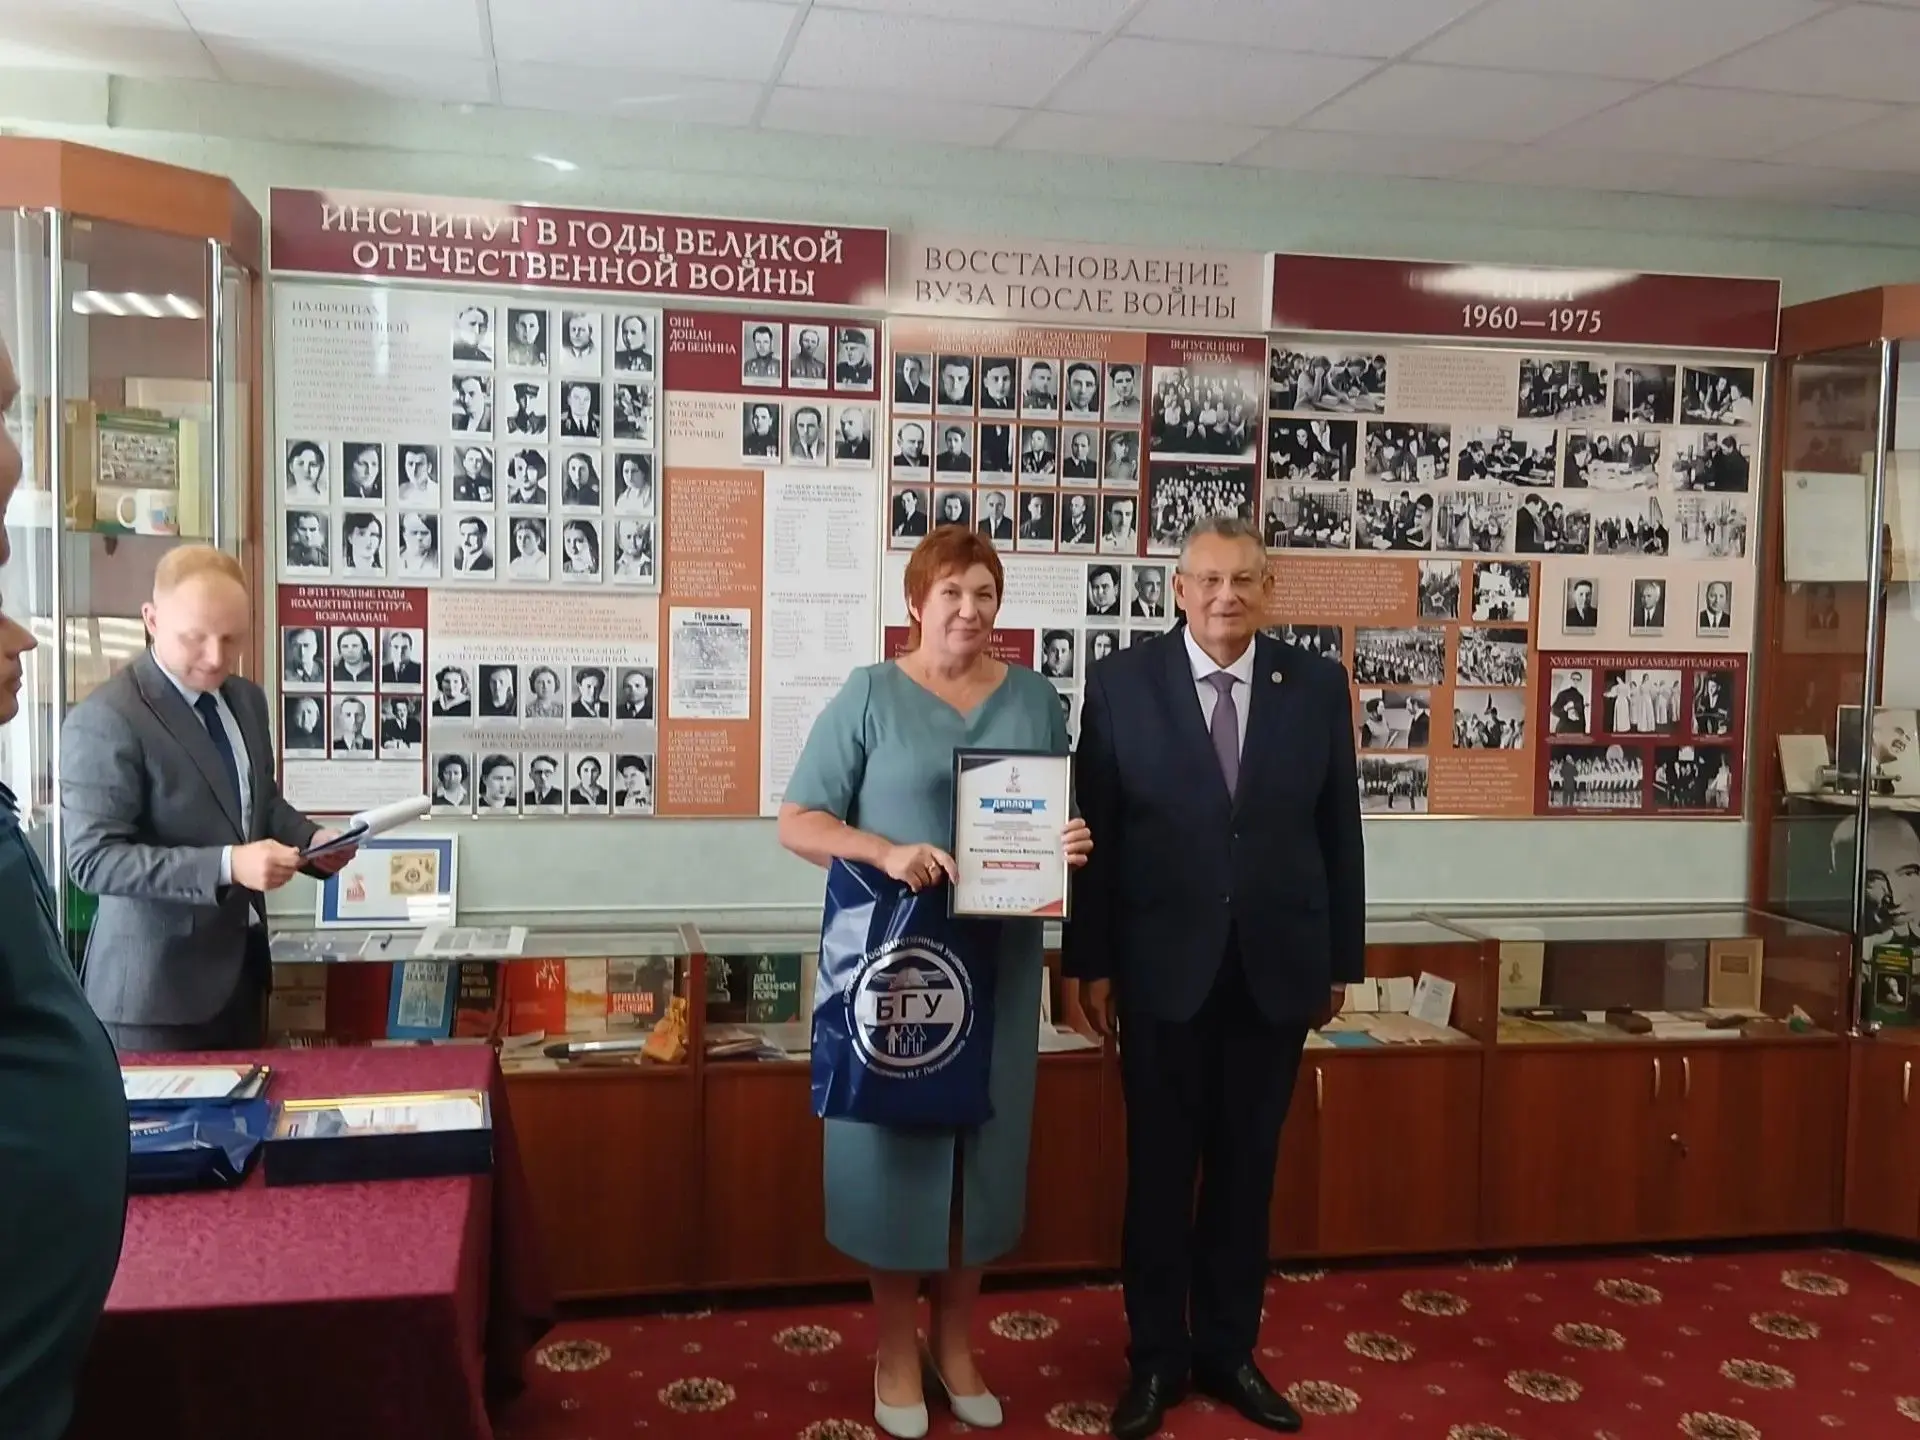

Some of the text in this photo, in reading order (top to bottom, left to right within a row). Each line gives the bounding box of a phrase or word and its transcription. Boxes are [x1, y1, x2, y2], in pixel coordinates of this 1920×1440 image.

[320, 203, 843, 264] ИНСТИТУТ В ГОДЫ ВЕЛИКОЙ
[352, 241, 815, 296] ОТЕЧЕСТВЕННОЙ ВОЙНЫ
[925, 247, 1229, 287] ВОССТАНОВЛЕНИЕ
[915, 279, 1237, 319] ВУЗА ПОСЛЕ ВОЙНЫ
[669, 341, 686, 353] ДО
[876, 993, 943, 1021] БГУ
